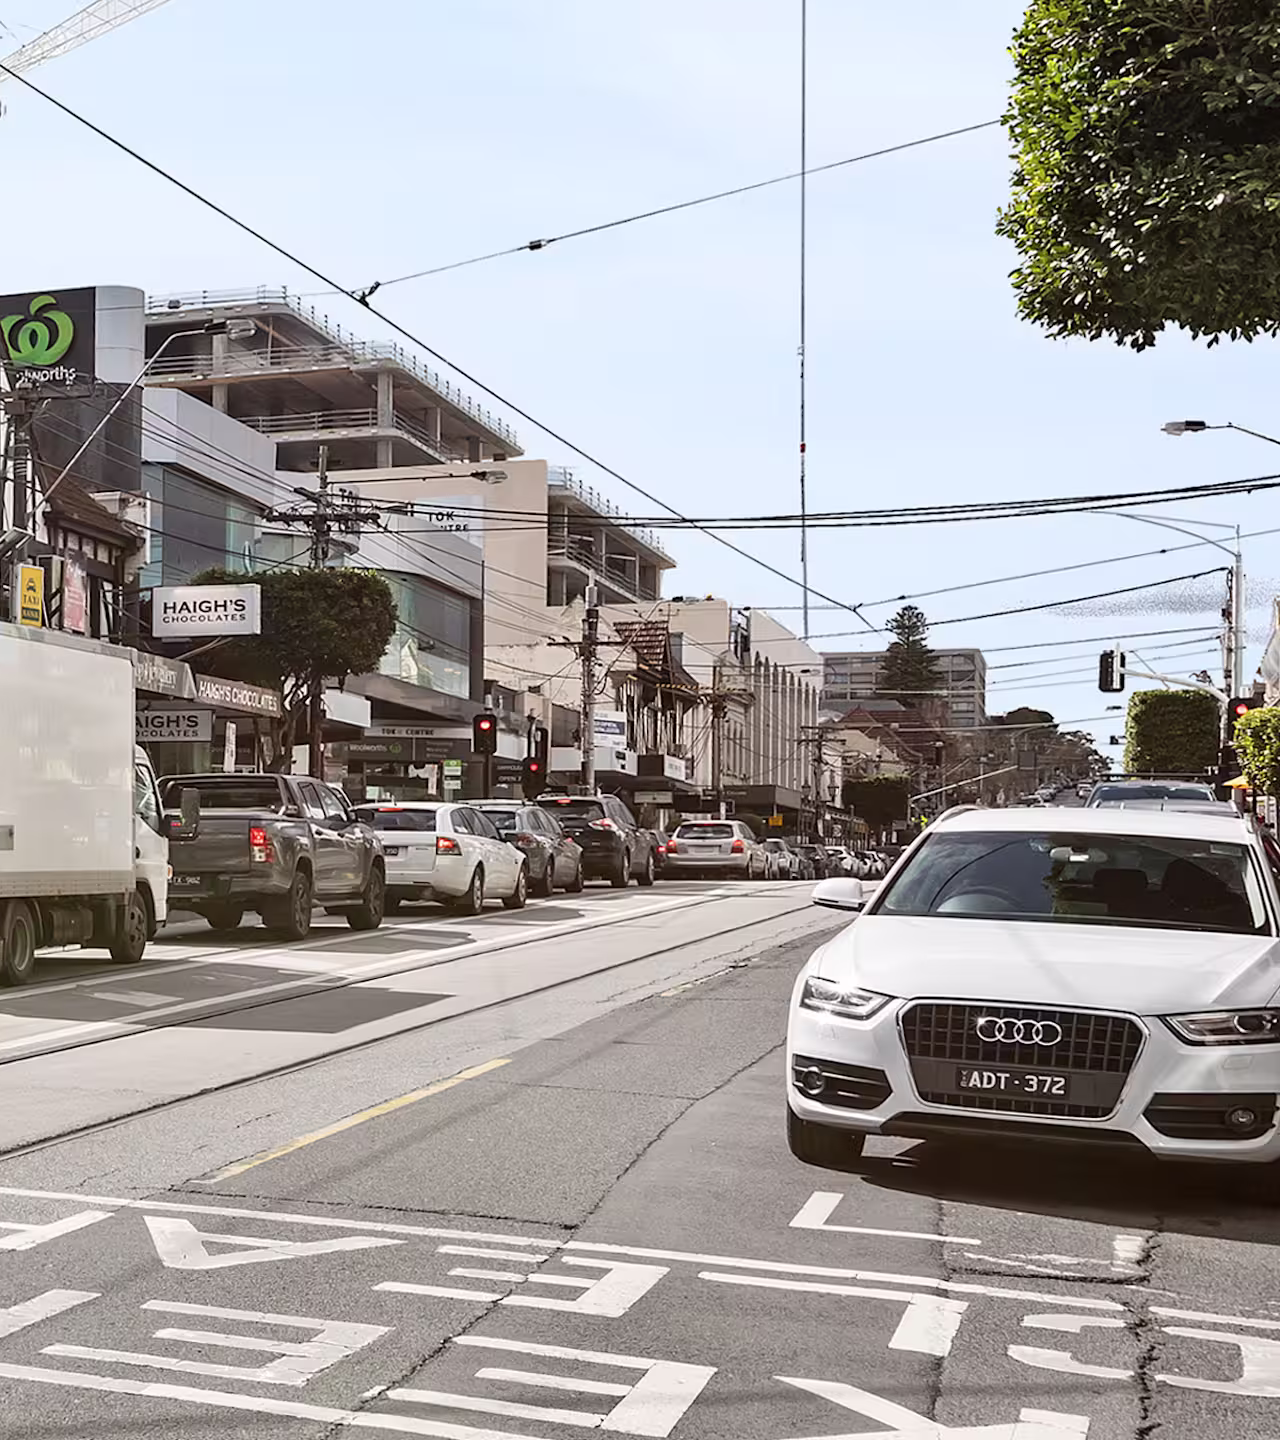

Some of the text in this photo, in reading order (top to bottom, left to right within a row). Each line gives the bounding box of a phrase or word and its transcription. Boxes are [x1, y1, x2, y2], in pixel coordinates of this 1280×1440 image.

[162, 599, 247, 615] HAIGH'S
[162, 613, 247, 624] CHOCOLATES
[198, 680, 278, 711] HAIGH'S CHOCOLATES
[136, 714, 199, 728] AIGH'S
[349, 743, 388, 752] Woolworths
[968, 1070, 1011, 1090] ADT
[1023, 1074, 1066, 1095] 372
